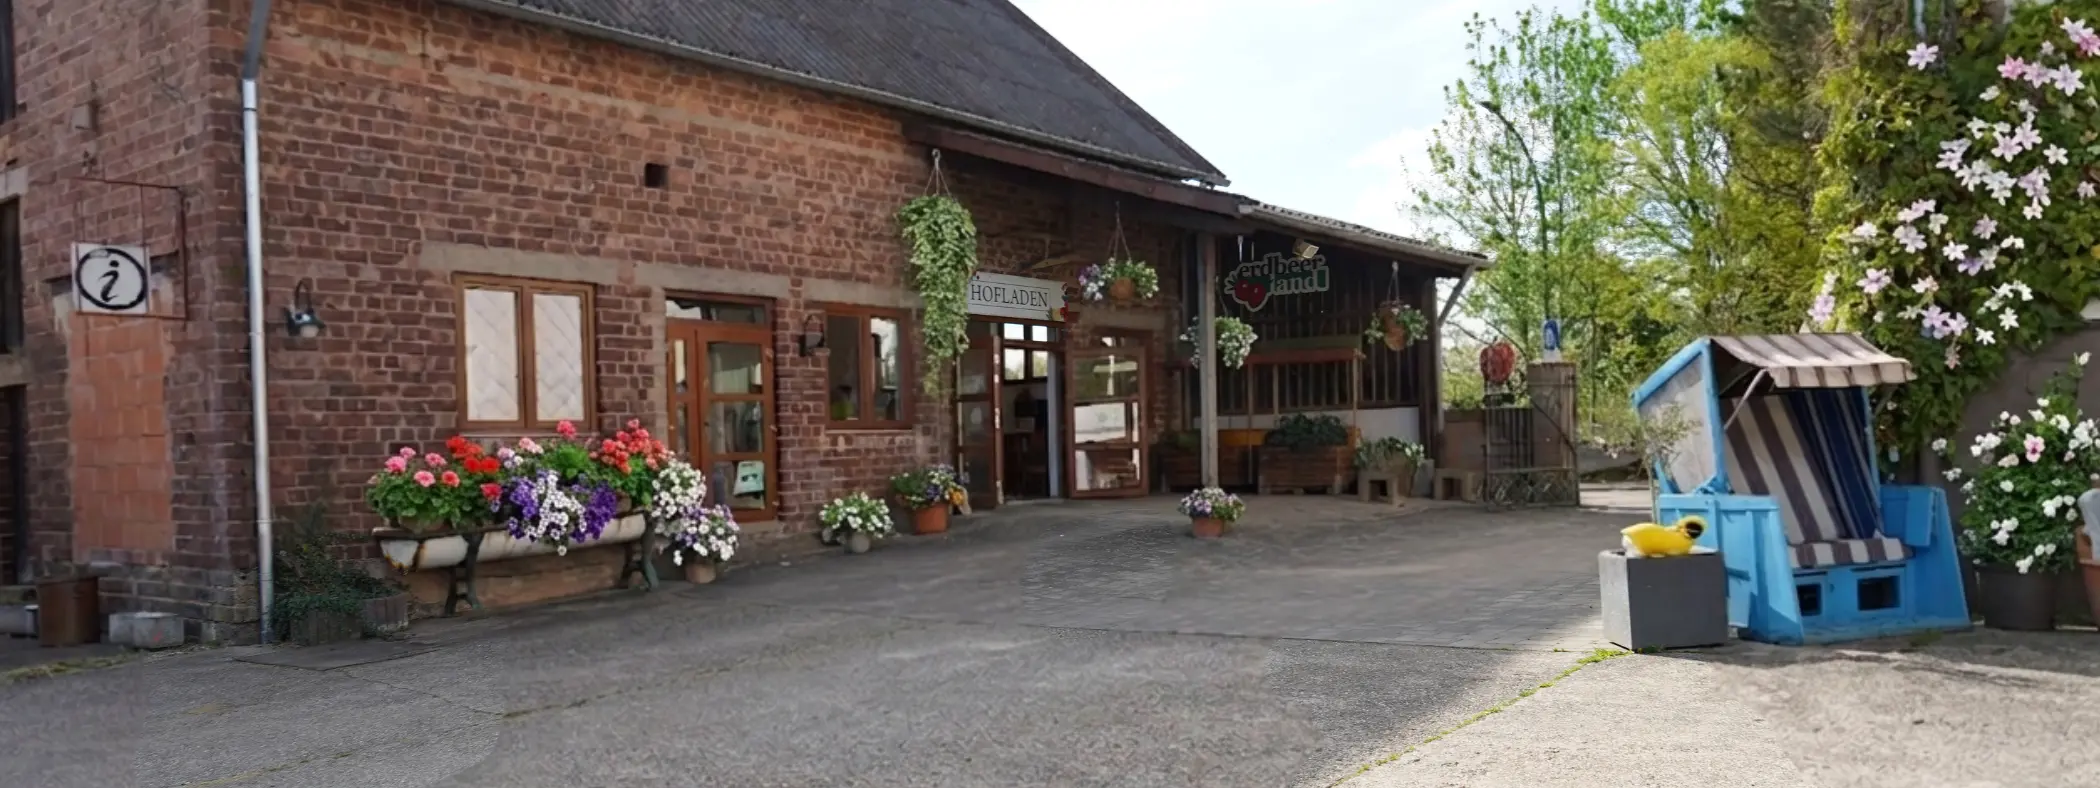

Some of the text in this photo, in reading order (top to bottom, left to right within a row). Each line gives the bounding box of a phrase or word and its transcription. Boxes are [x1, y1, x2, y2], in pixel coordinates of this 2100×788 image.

[1240, 256, 1324, 277] erdbeer
[1270, 271, 1315, 294] land
[971, 284, 1048, 307] HOFLADEN
